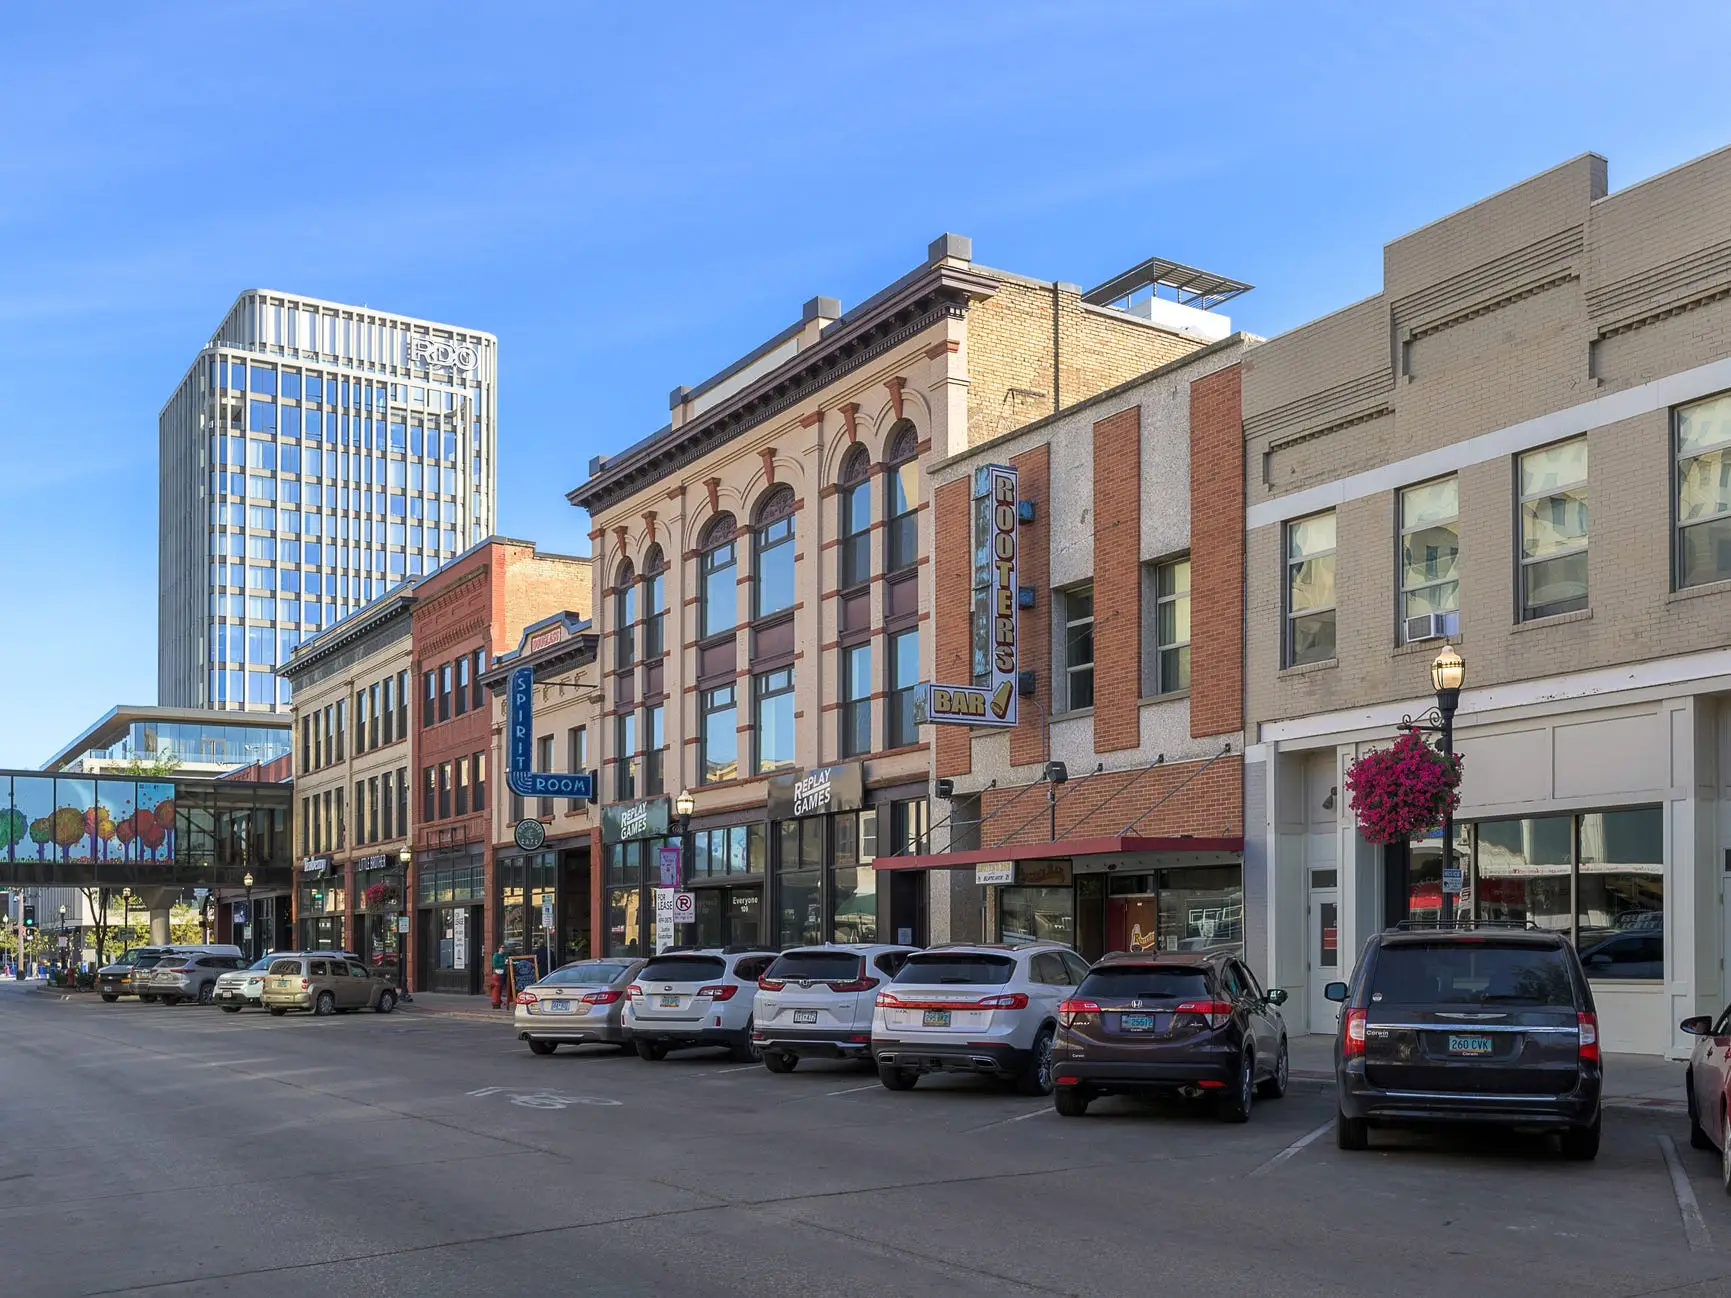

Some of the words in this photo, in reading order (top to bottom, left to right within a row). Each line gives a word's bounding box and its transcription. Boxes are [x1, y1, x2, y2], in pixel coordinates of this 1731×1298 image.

[411, 337, 478, 371] RDO
[994, 475, 1015, 674] ROOTERS
[934, 689, 986, 716] BAR
[516, 677, 526, 772] SPIRIT
[536, 778, 585, 792] ROOM
[794, 768, 831, 801] REPLAY
[621, 801, 647, 828] REPLAY
[794, 786, 831, 816] GAMES
[621, 817, 647, 840] GAMES
[657, 901, 673, 911] LEASE
[1451, 1040, 1469, 1050] 260
[1471, 1040, 1489, 1050] CVK
